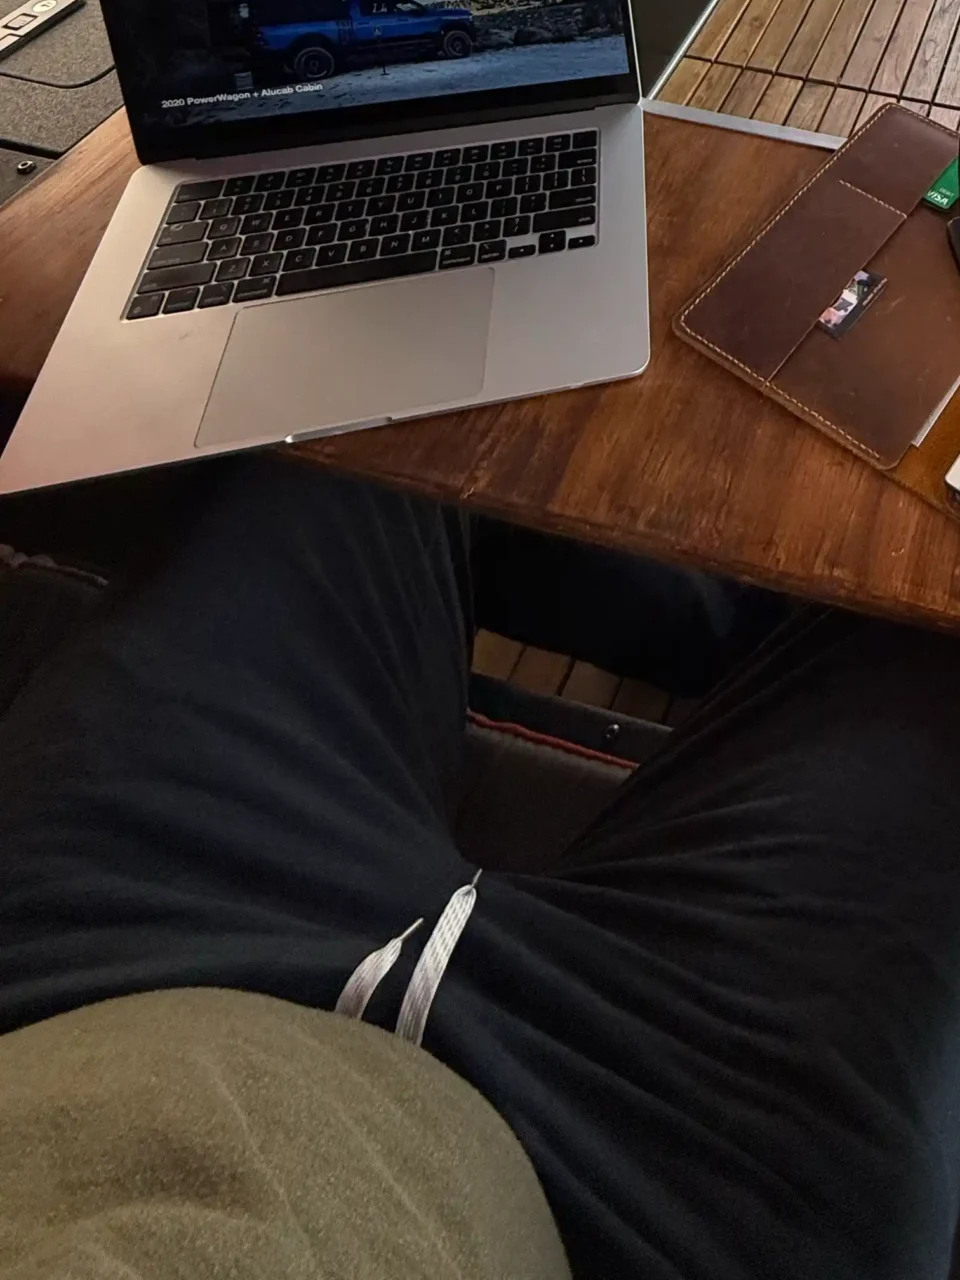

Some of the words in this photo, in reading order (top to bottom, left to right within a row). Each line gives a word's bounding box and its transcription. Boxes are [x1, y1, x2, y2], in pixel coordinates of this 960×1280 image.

[161, 98, 186, 109] 2020
[186, 92, 252, 106] PowerWagon
[261, 87, 294, 97] Alucab
[295, 83, 324, 93] Cabin
[927, 190, 949, 205] VISA
